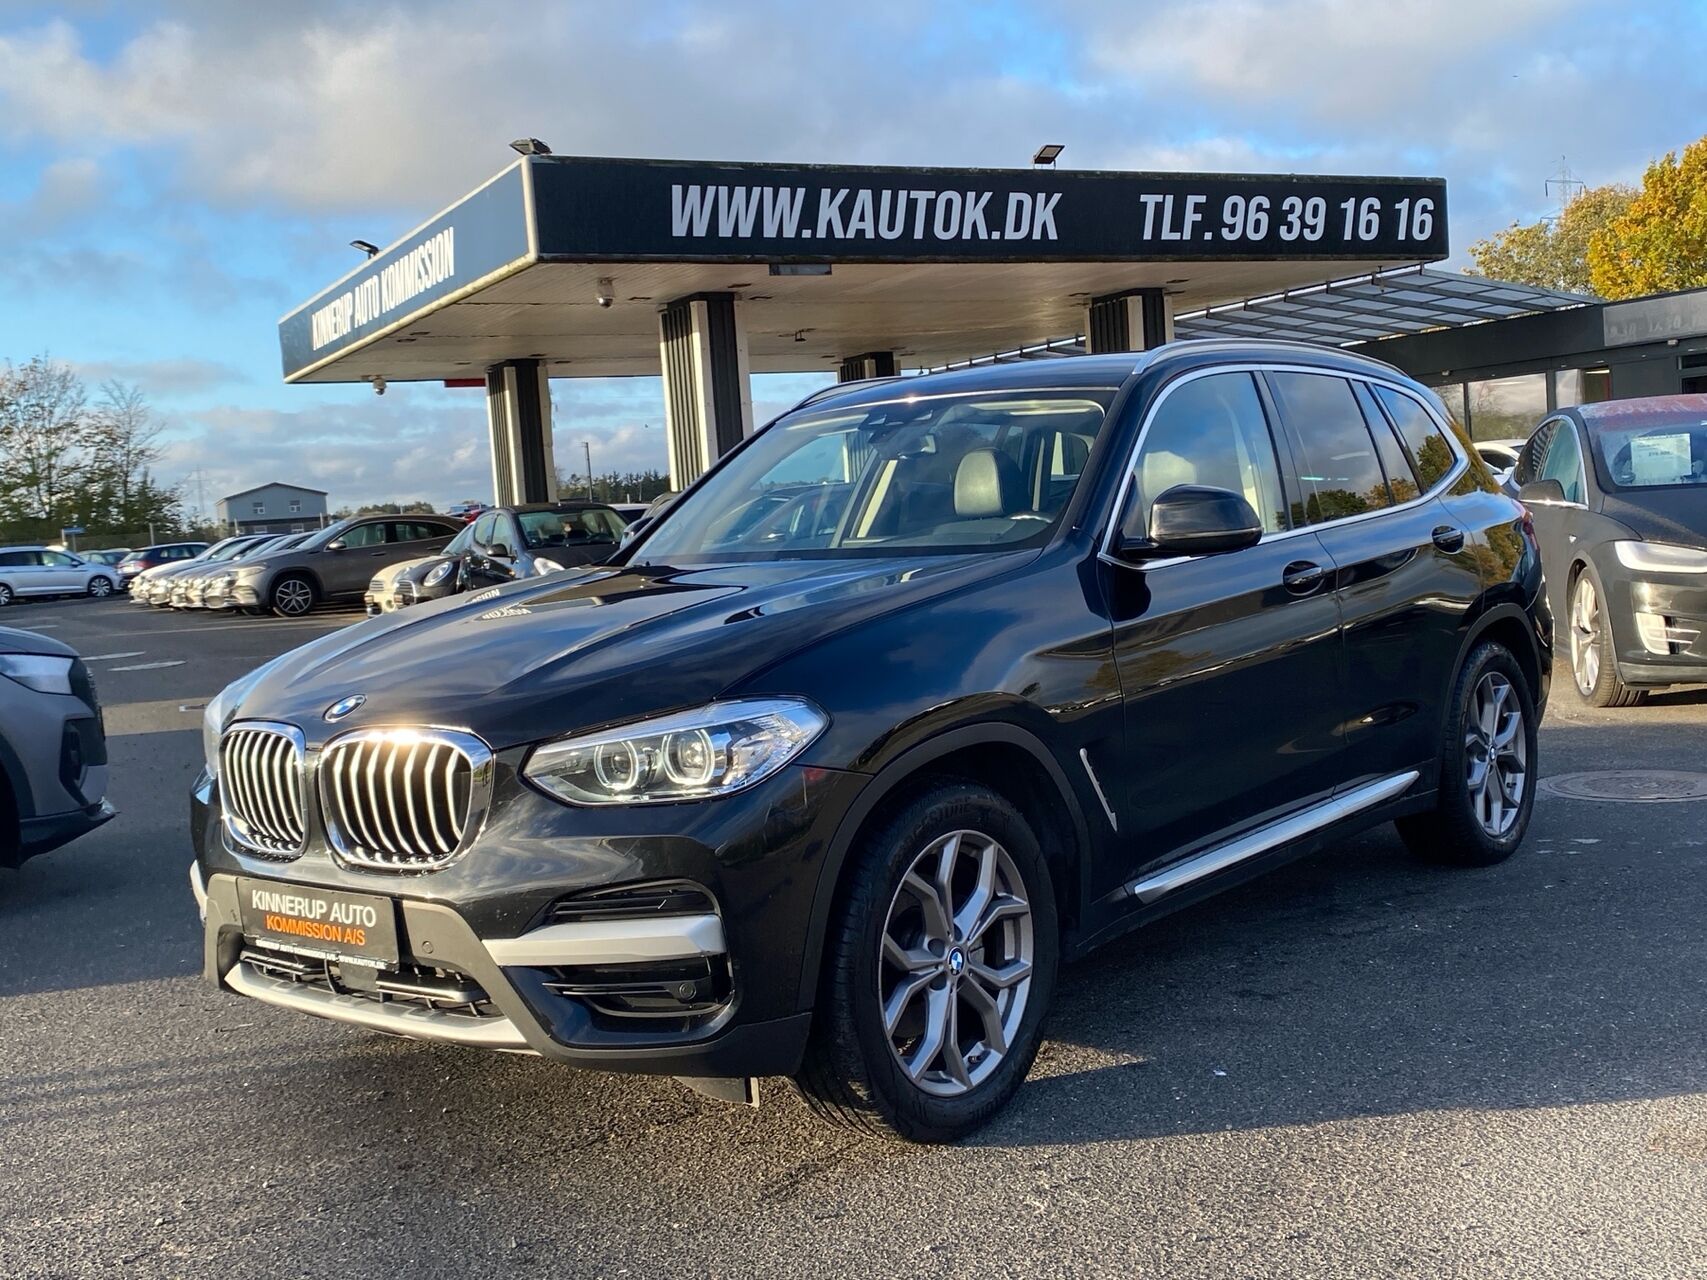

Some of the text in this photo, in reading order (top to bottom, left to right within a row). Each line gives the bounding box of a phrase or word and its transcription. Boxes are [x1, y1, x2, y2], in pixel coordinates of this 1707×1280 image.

[671, 184, 1062, 240] WWW.KAUTOK.DK
[1140, 194, 1434, 241] TLF. 96 39 16 16
[311, 227, 455, 350] KINNERUP AUTO KOMMISSION
[252, 889, 376, 928] KINNERUP AUTO
[266, 915, 342, 942] KOMMISSION
